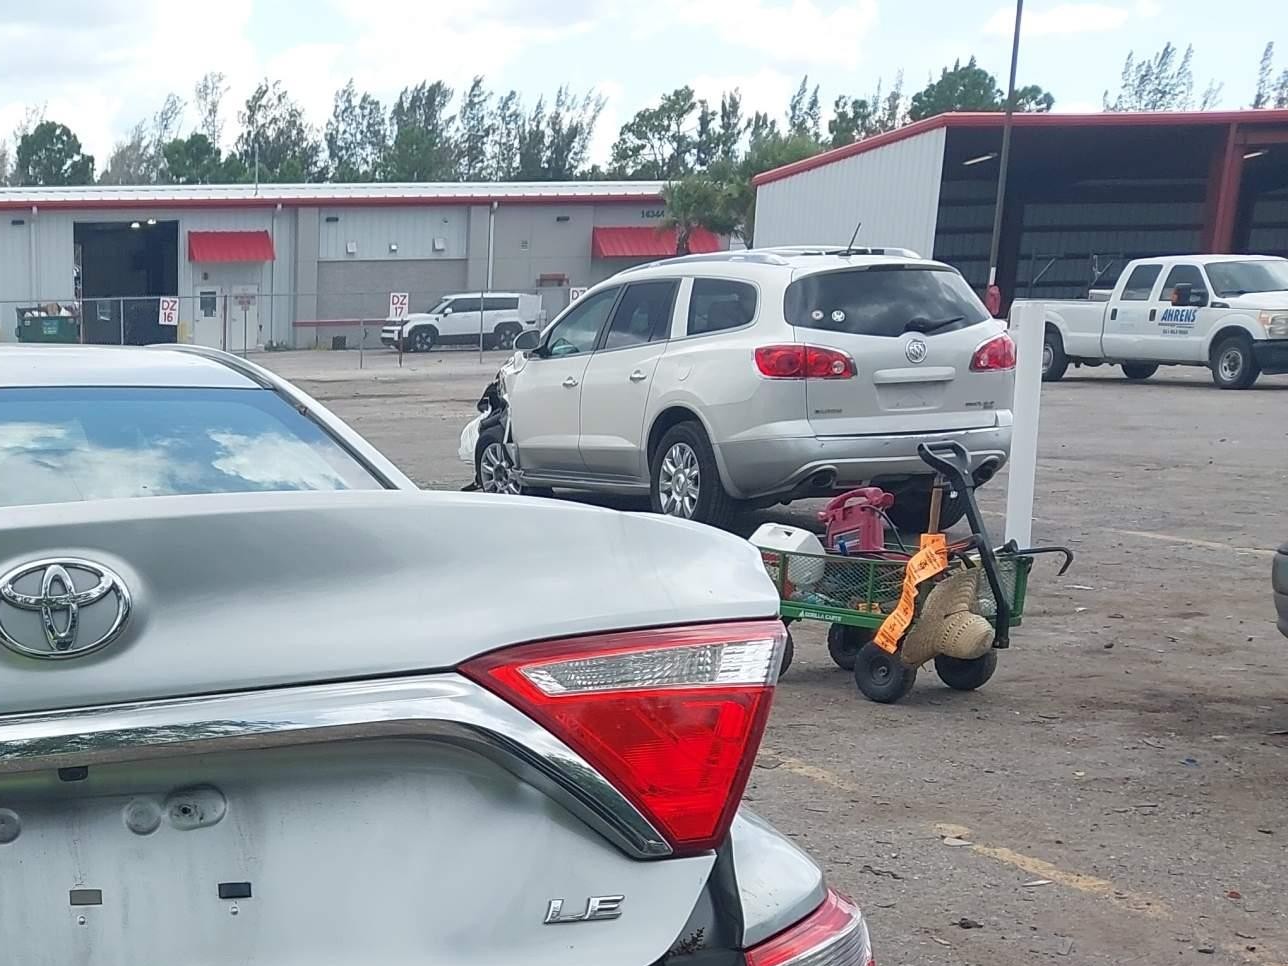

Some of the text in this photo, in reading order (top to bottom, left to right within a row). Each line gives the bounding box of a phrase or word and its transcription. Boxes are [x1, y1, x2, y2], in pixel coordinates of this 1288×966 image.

[161, 300, 178, 311] DZ
[391, 295, 408, 306] DZ
[163, 311, 174, 322] 16
[394, 306, 404, 317] 17
[1160, 308, 1198, 322] AHRENS
[543, 894, 625, 925] LE
